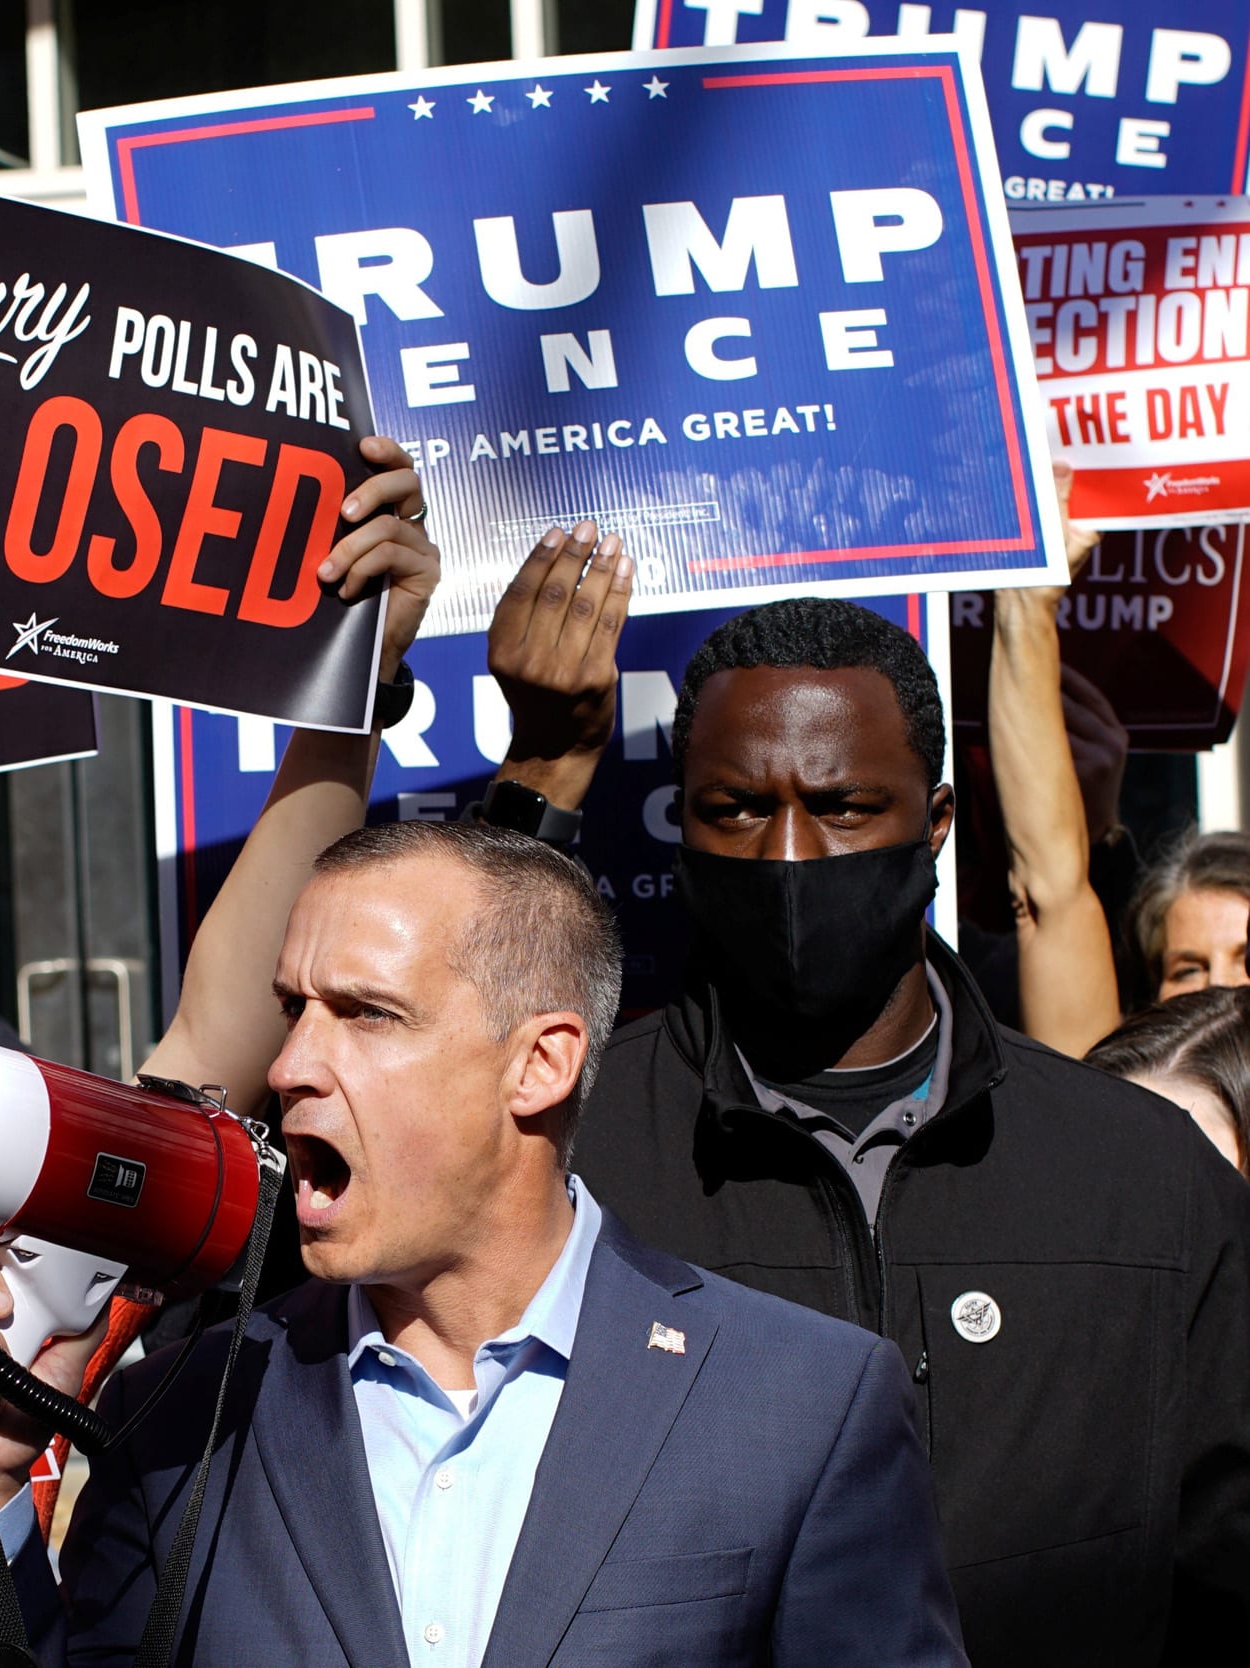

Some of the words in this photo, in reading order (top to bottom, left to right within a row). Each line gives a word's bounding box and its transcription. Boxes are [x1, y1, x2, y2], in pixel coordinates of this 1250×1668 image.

[1016, 239, 1146, 299] TING
[400, 309, 894, 408] ENCE
[1024, 287, 1250, 375] ECTION
[108, 306, 258, 406] POLLS
[265, 342, 350, 430] ARE
[398, 438, 450, 469] EP
[470, 417, 667, 463] AMERICA
[682, 403, 836, 441] GREAT!
[1049, 391, 1131, 447] THE
[1146, 383, 1230, 442] DAY
[43, 629, 119, 654] FreedomWorks
[1056, 594, 1174, 631] RUMP
[53, 645, 98, 664] AMERICA
